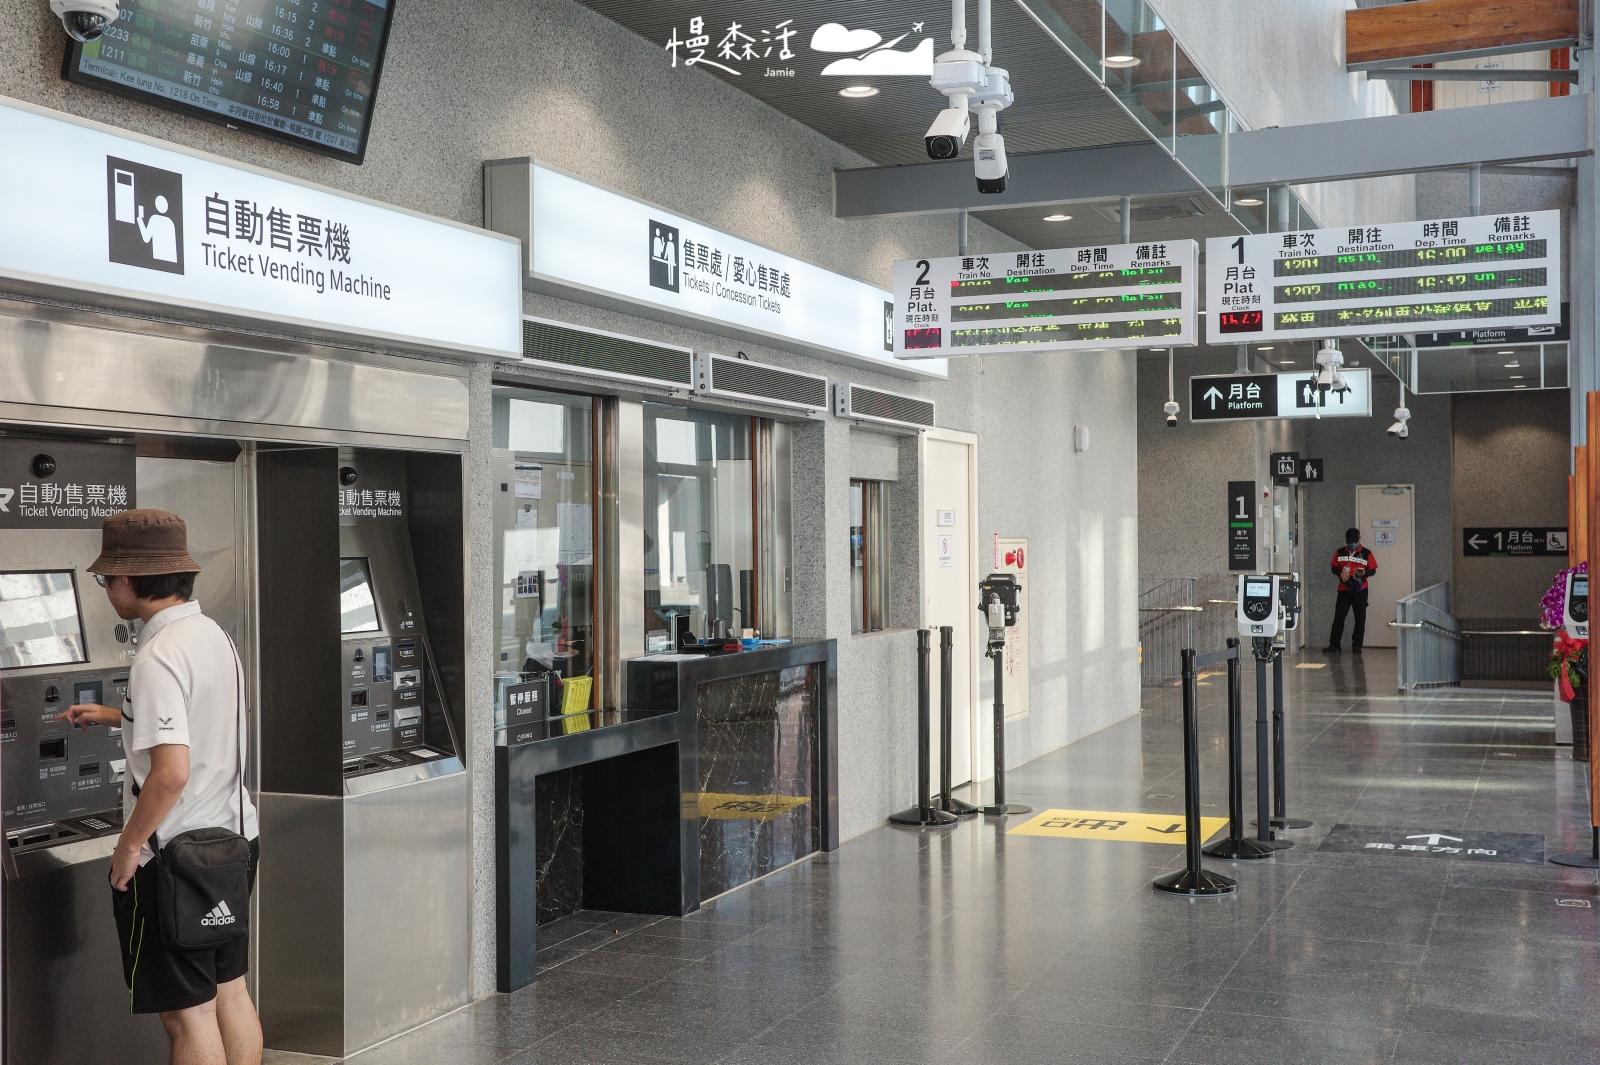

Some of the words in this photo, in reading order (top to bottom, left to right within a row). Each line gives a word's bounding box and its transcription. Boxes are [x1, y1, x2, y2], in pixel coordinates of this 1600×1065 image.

[275, 6, 298, 22] 16:15
[309, 20, 314, 30] 2
[312, 3, 317, 12] 2
[194, 14, 213, 31] 新竹
[268, 42, 290, 58] 16:00
[303, 55, 306, 64] 1
[217, 40, 232, 50] Miao
[271, 24, 294, 40] 16:36
[305, 37, 311, 47] 2
[190, 33, 209, 49] 苗栗
[239, 51, 256, 65] 山線
[264, 60, 287, 75] 16:17
[299, 72, 303, 81] 1
[83, 59, 119, 79] Terminal:
[120, 70, 135, 83] Kee
[137, 75, 152, 89] lung
[154, 81, 167, 93] No.
[170, 87, 188, 99] 1218
[190, 92, 200, 103] On
[202, 95, 218, 108] Time
[101, 45, 125, 61] 1211
[183, 70, 201, 86] 新竹
[257, 95, 279, 110] 16:58
[292, 106, 296, 115] 1
[208, 86, 219, 94] chu
[235, 69, 252, 83] 山線
[261, 77, 283, 93] 16:40
[296, 89, 299, 98] 1
[323, 133, 338, 145] 1201
[204, 192, 352, 265] 自動售票機
[1283, 233, 1315, 249] 車次
[1348, 228, 1382, 245] 開往
[1423, 220, 1458, 238] 時間
[1494, 215, 1530, 234] 備註
[1231, 237, 1244, 264] 1
[1279, 250, 1301, 258] Train
[1304, 248, 1320, 256] No.
[1337, 243, 1394, 254] Destination
[1415, 239, 1438, 248] Dep.
[1441, 237, 1467, 246] Time
[1488, 232, 1536, 242] Remarks
[683, 238, 723, 279] 售票處
[733, 255, 791, 299] 愛心售票處
[962, 256, 989, 271] 車次
[1016, 253, 1045, 268] 開往
[1078, 248, 1107, 263] 時間
[1136, 244, 1166, 260] 備註
[201, 241, 254, 274] Ticket
[258, 254, 326, 294] Vending
[330, 271, 391, 301] Machine
[915, 260, 930, 285] 2
[958, 272, 978, 280] Train
[980, 271, 993, 279] No.
[1007, 267, 1055, 276] Destination
[1071, 264, 1090, 272] Dep.
[1093, 262, 1114, 270] Time
[1131, 259, 1170, 268] Remarks
[1226, 266, 1256, 280] 月台
[683, 272, 710, 295] Tickets
[716, 282, 757, 307] Concession
[758, 291, 781, 314] Tickets
[909, 287, 935, 300] 月台
[1221, 295, 1261, 306] 現在時刻
[908, 302, 937, 312] Plat.
[905, 314, 939, 323] 現在時刻
[1473, 330, 1506, 340] Platform
[1228, 382, 1261, 400] 月台
[1228, 401, 1263, 410] Platform
[20, 482, 128, 506] 自動售票機
[18, 505, 48, 517] Ticket
[50, 506, 89, 519] Vending
[352, 507, 377, 518] Vending
[377, 507, 402, 516] Machine
[1235, 496, 1249, 519] 1
[1494, 532, 1502, 550] 1
[1507, 531, 1534, 543] 月台
[516, 707, 532, 716] Closed
[201, 915, 236, 927] adidas
